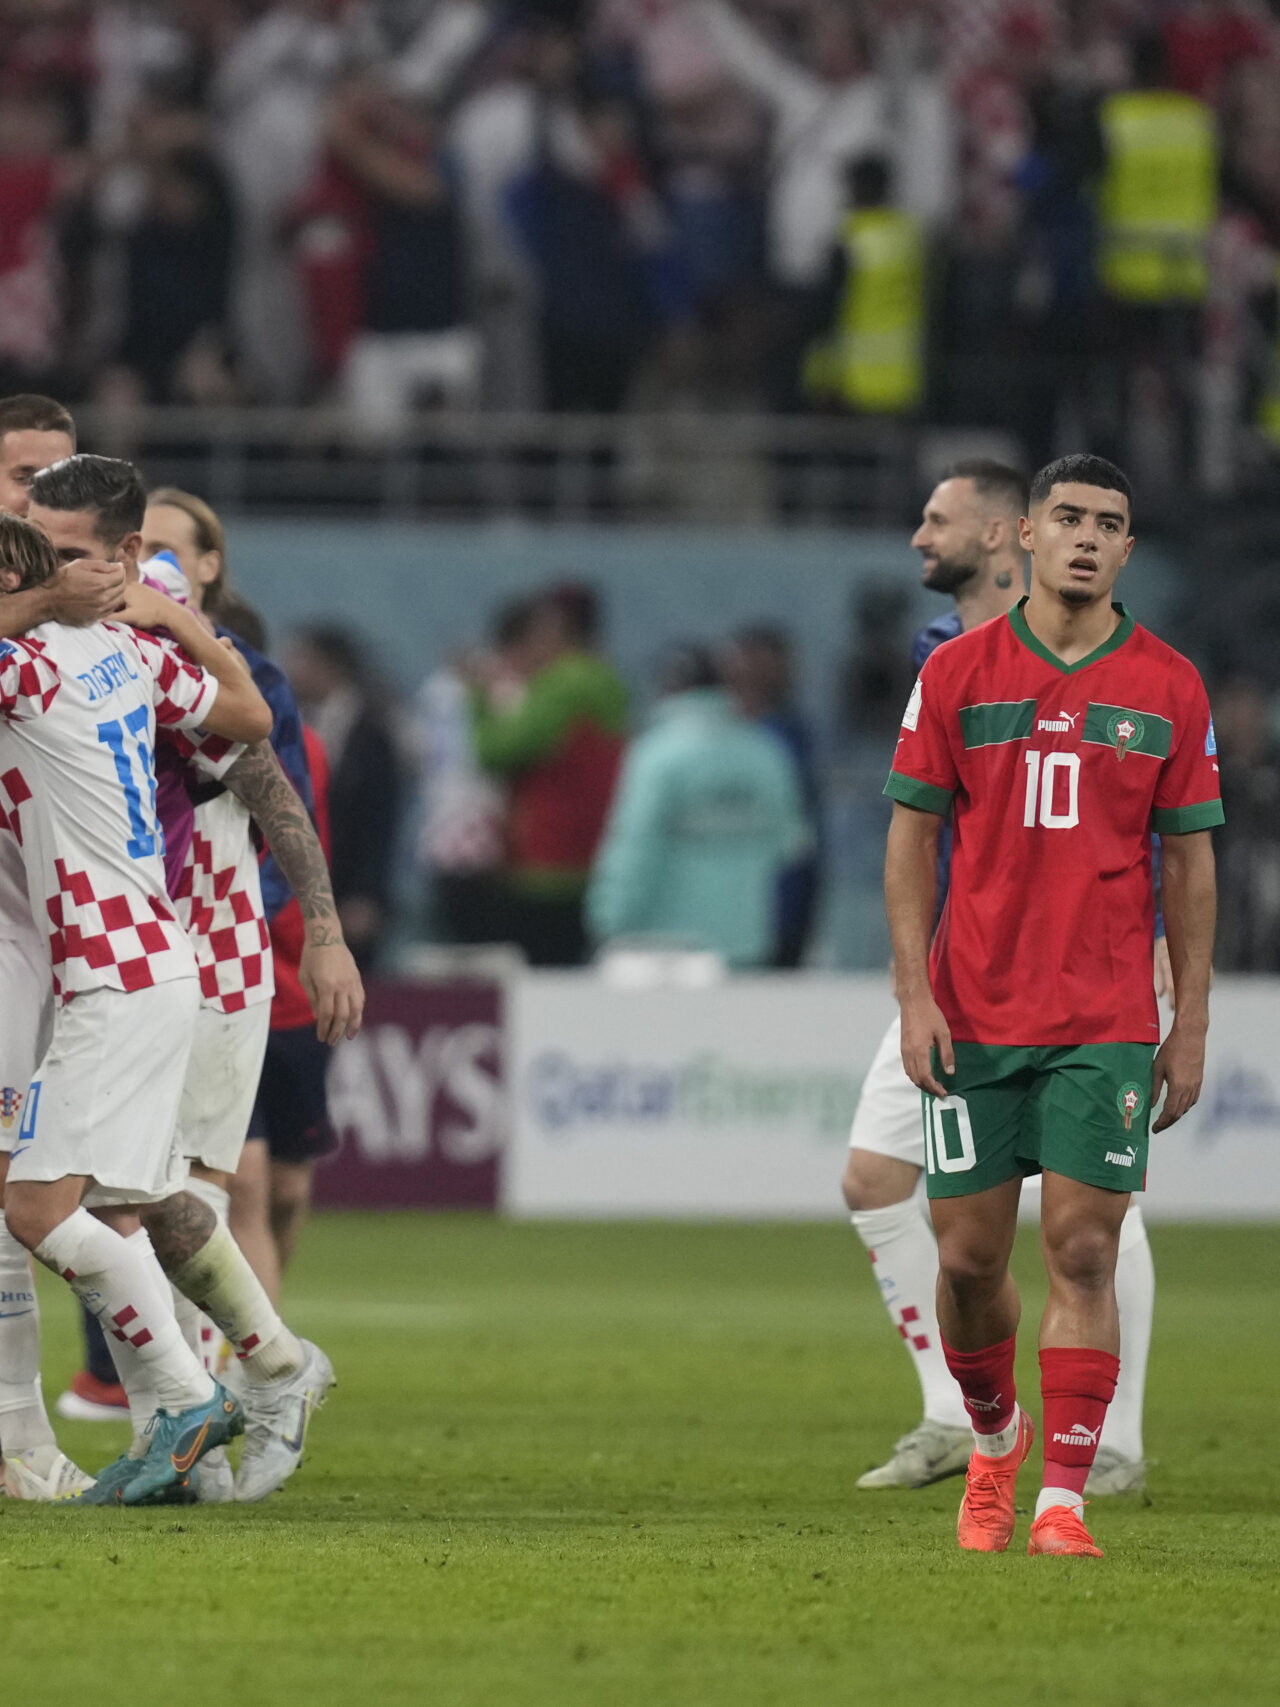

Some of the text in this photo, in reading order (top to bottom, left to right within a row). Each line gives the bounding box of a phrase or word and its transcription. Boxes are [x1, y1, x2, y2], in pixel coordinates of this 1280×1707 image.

[1037, 719, 1070, 732] PUMA
[1023, 750, 1081, 829] 10
[925, 1094, 977, 1174] 10
[1053, 1432, 1092, 1447] PUMA
